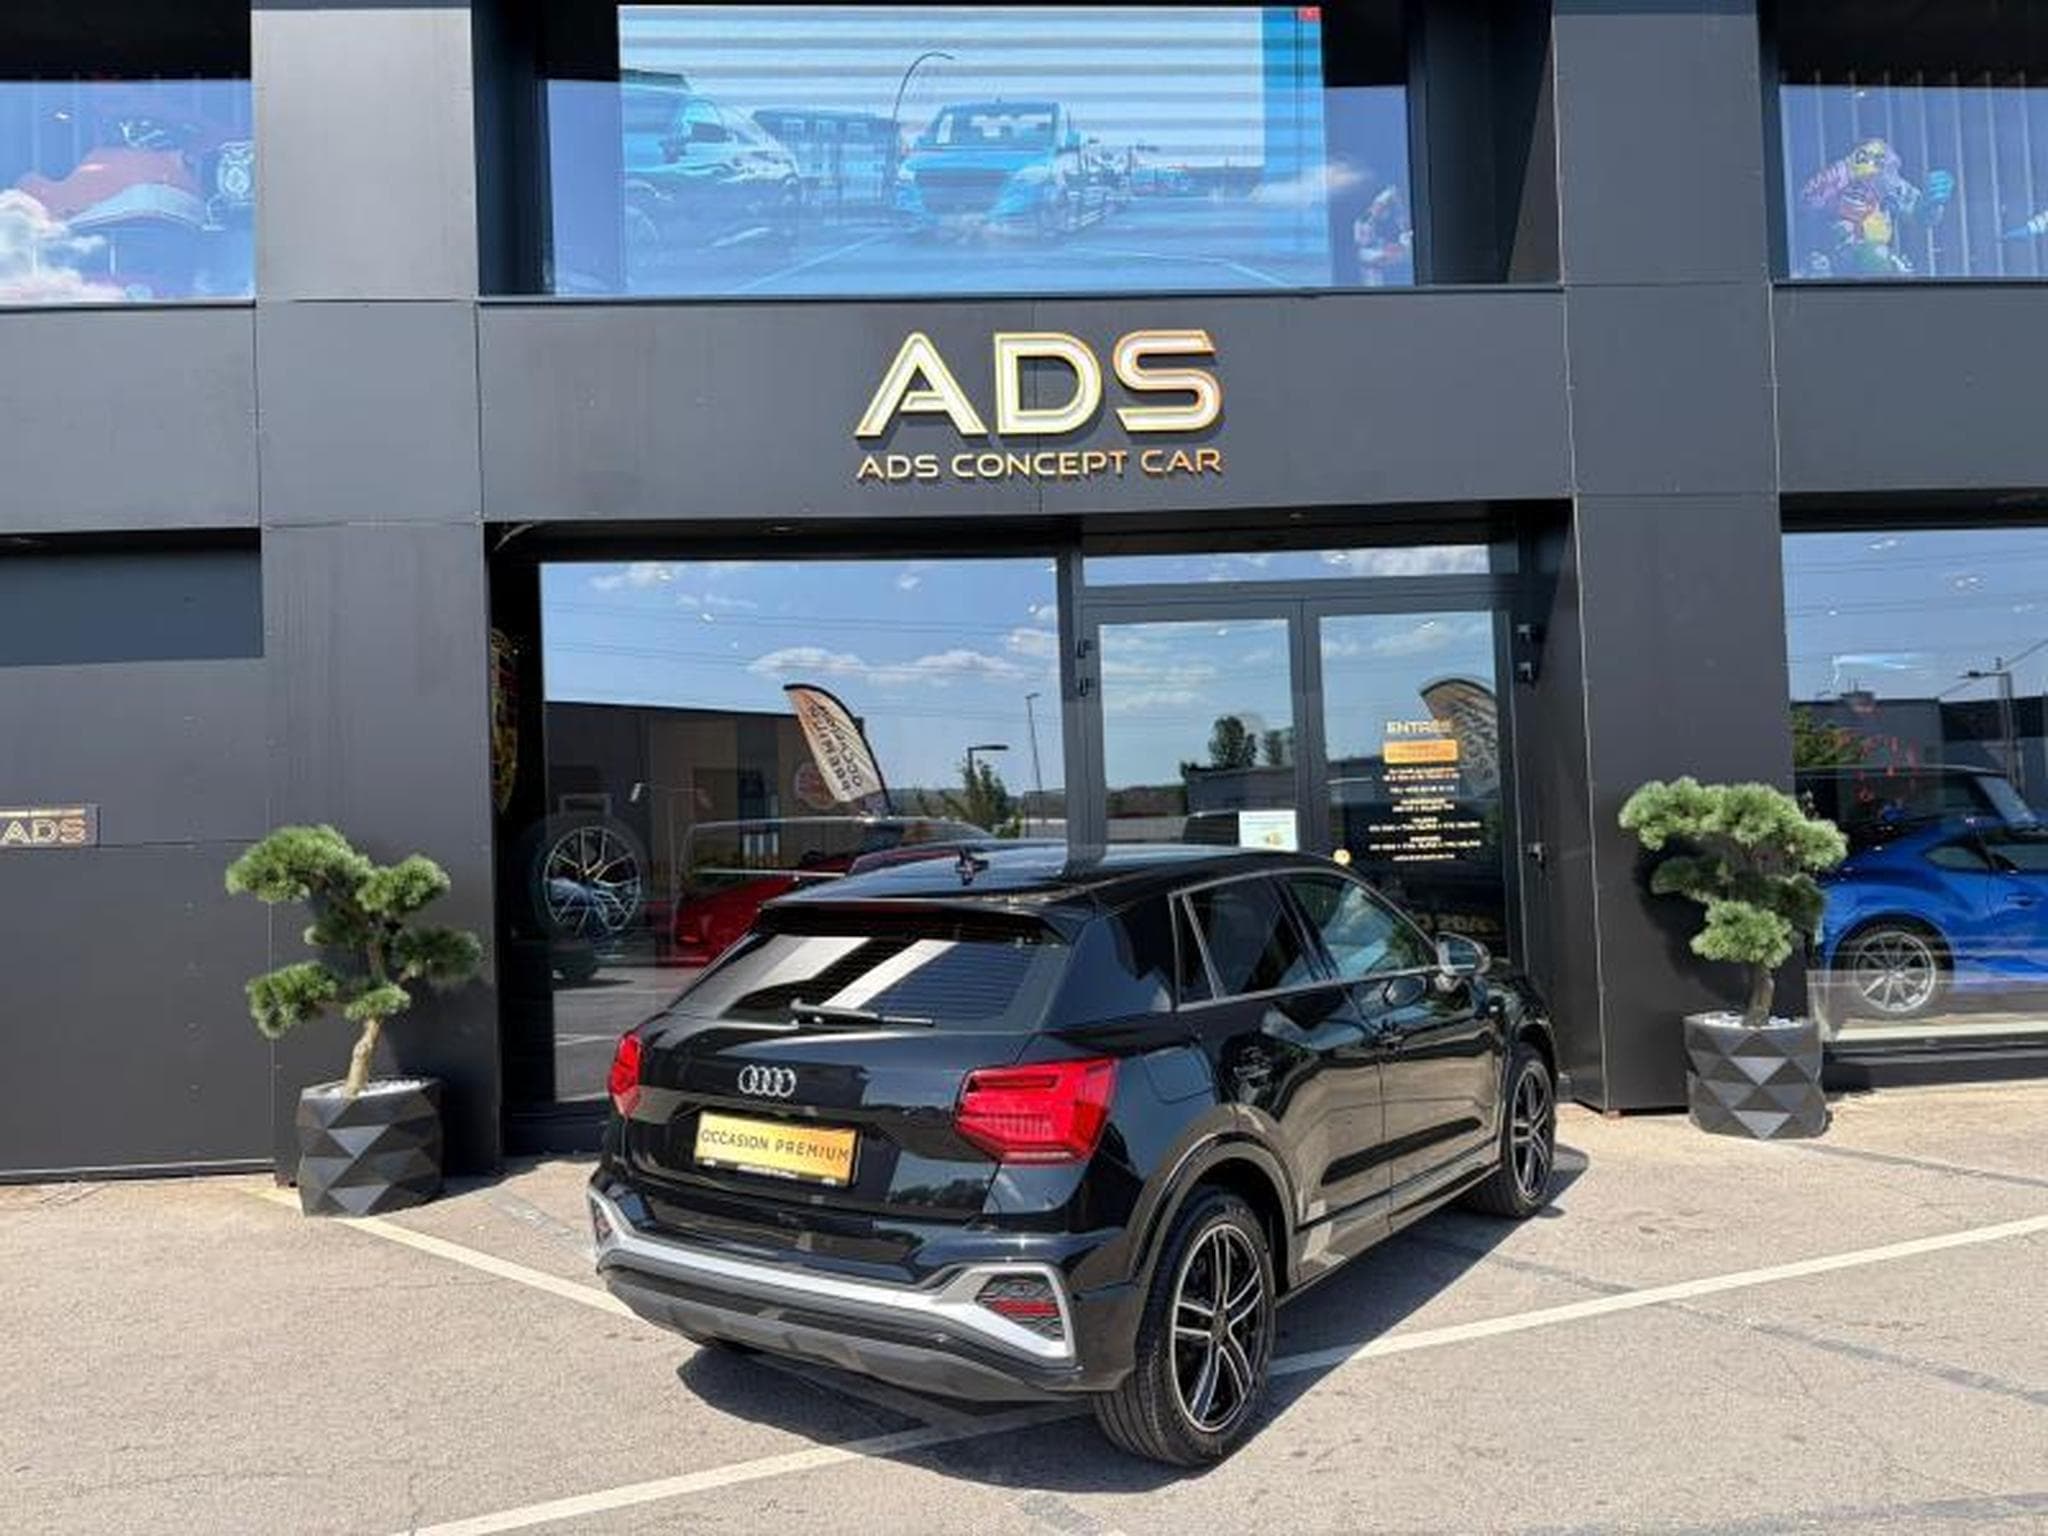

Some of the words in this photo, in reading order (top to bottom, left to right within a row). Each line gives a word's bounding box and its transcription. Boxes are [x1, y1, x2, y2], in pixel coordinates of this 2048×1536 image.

[855, 329, 1221, 437] ADS
[856, 453, 938, 480] ADS
[951, 450, 1127, 477] CONCEPT
[1140, 450, 1221, 473] CAR
[0, 819, 86, 845] ADS
[701, 1128, 769, 1151] OCCASION
[775, 1138, 849, 1162] PREMIUM
